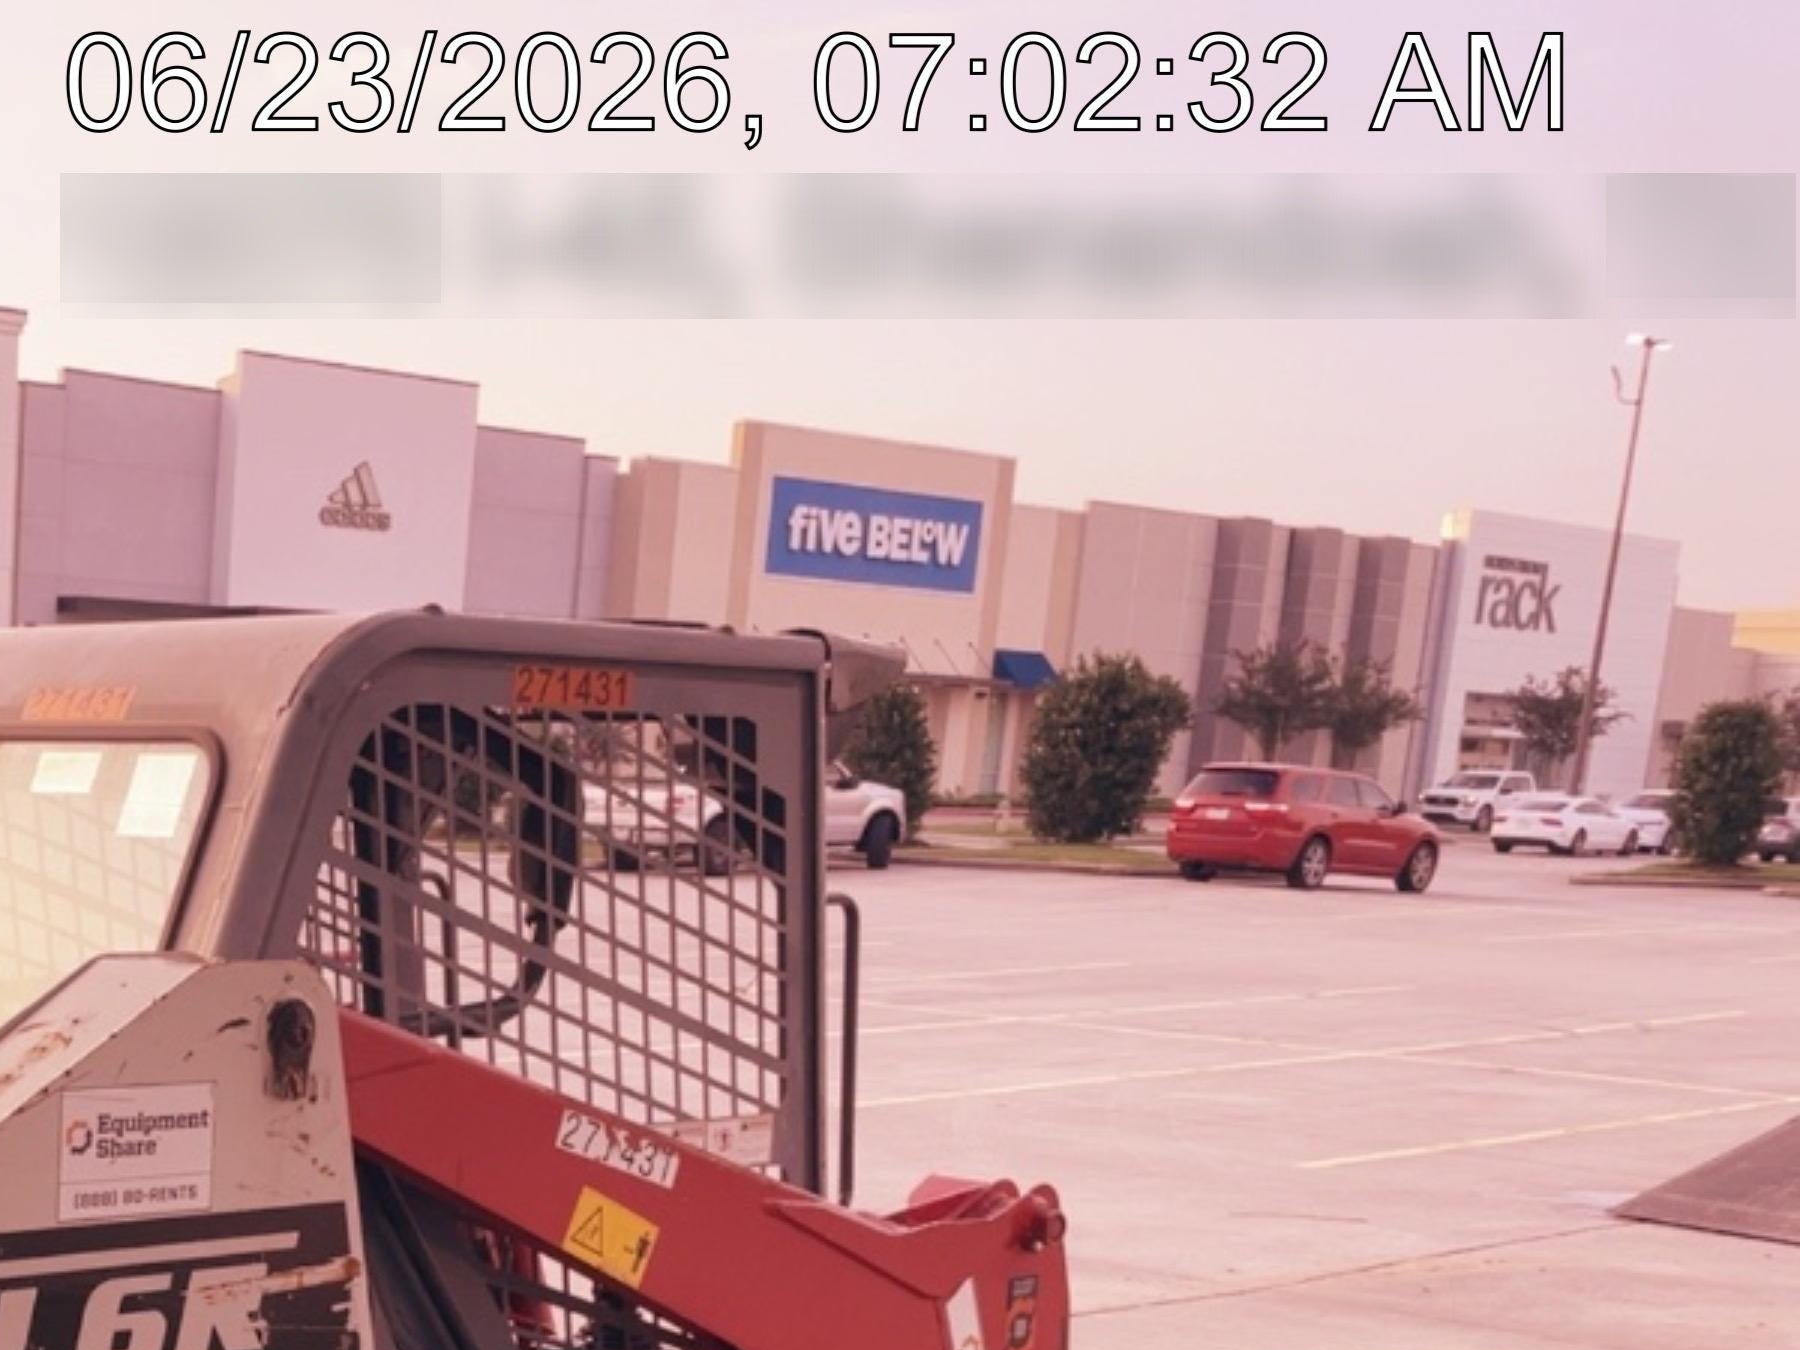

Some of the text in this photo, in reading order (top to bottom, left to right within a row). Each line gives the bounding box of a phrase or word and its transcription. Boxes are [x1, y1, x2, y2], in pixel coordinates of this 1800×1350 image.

[788, 504, 862, 557] five
[1475, 563, 1563, 633] rack
[515, 664, 628, 706] 271431
[96, 1109, 209, 1137] Equipment
[96, 1136, 157, 1159] Share
